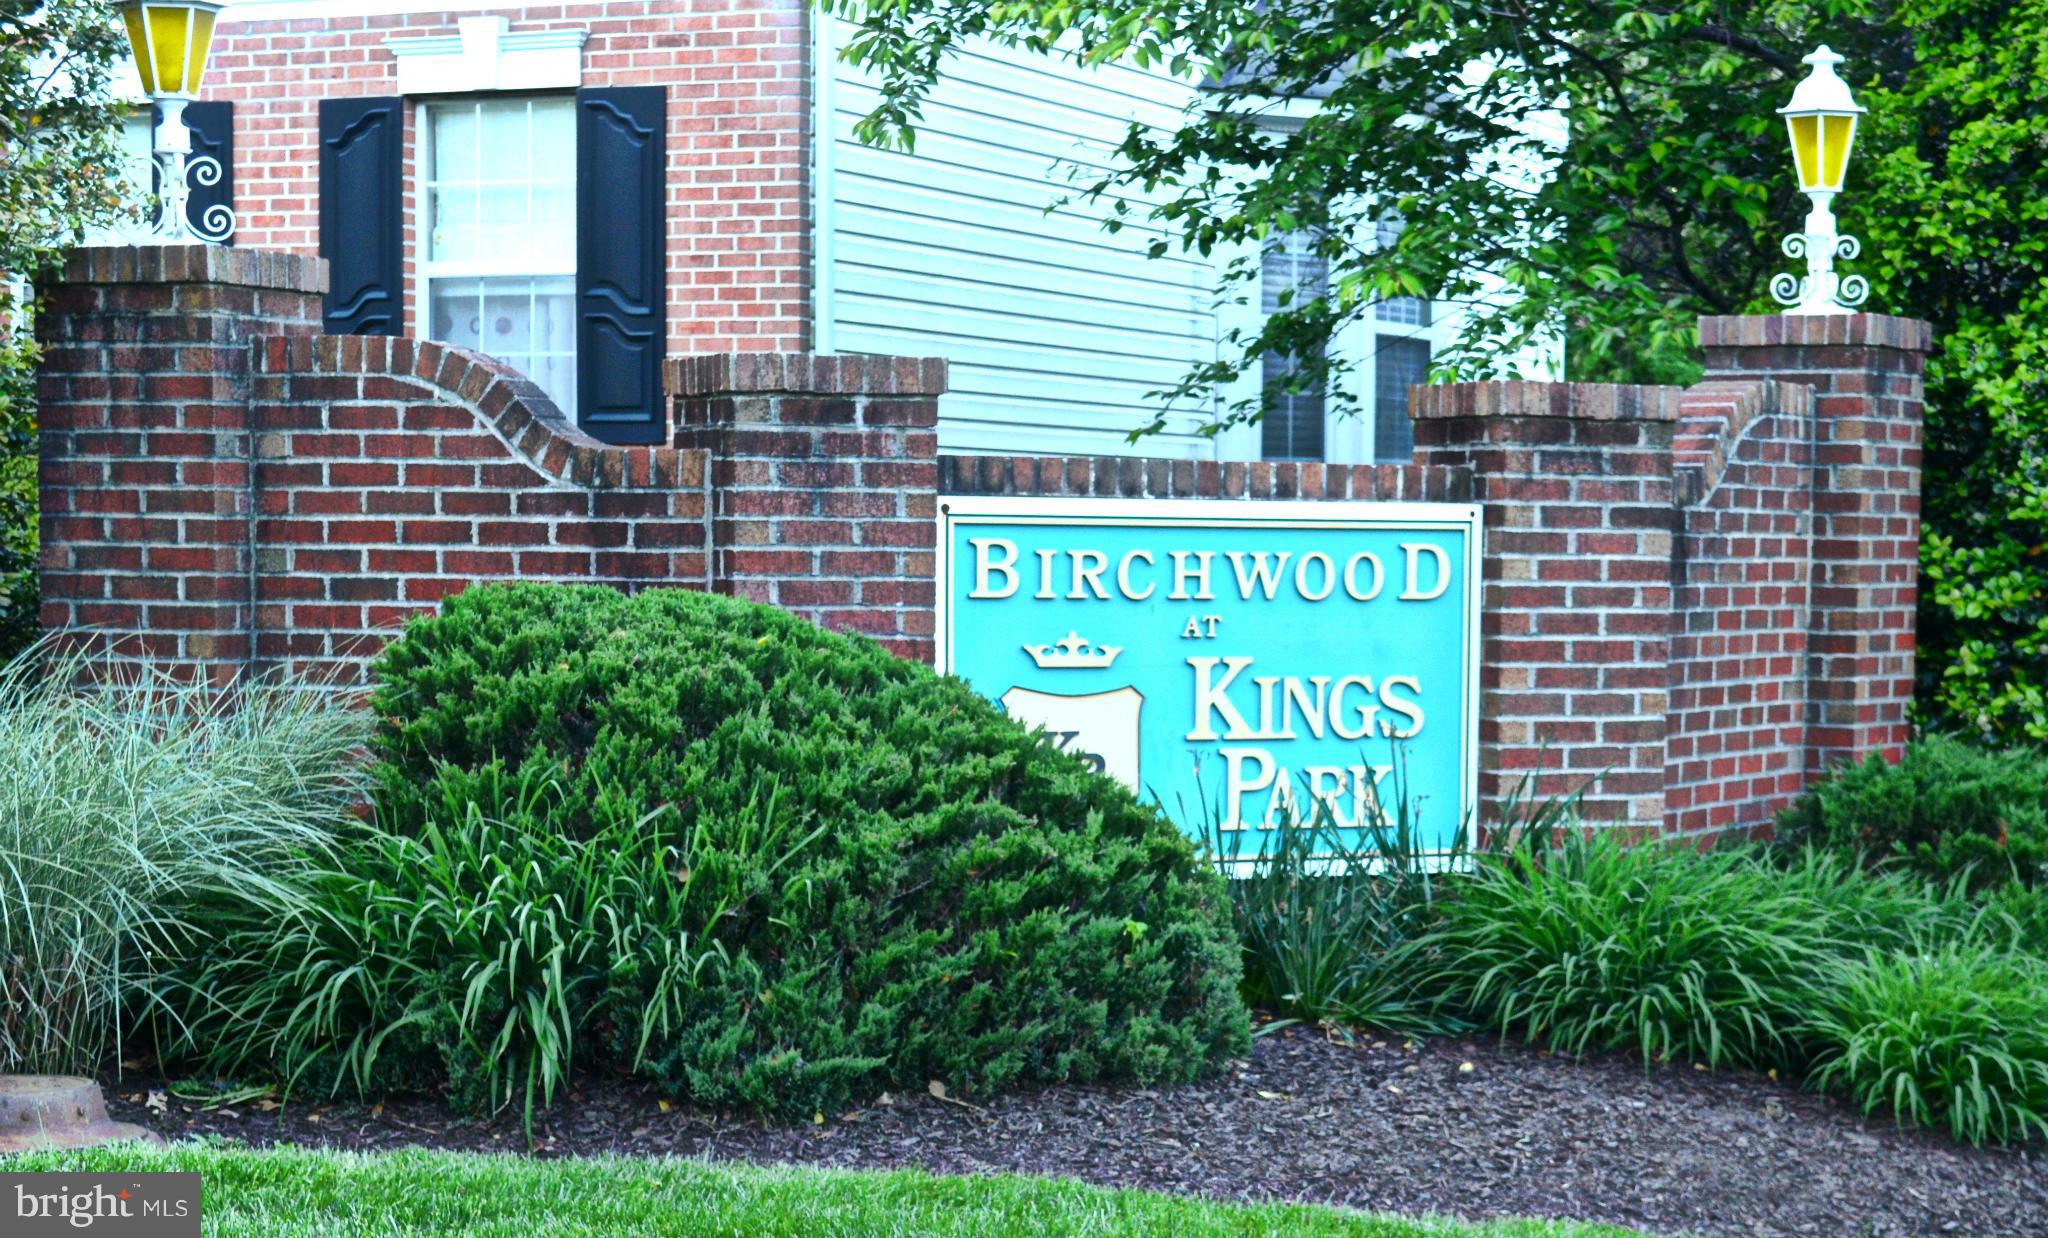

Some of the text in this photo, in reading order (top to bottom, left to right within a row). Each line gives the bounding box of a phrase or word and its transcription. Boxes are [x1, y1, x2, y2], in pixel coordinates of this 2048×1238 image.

[967, 536, 1451, 602] BIRCHWOOD
[1181, 614, 1222, 640] AT
[1184, 656, 1425, 742] KINGS
[1218, 747, 1397, 833] PARK
